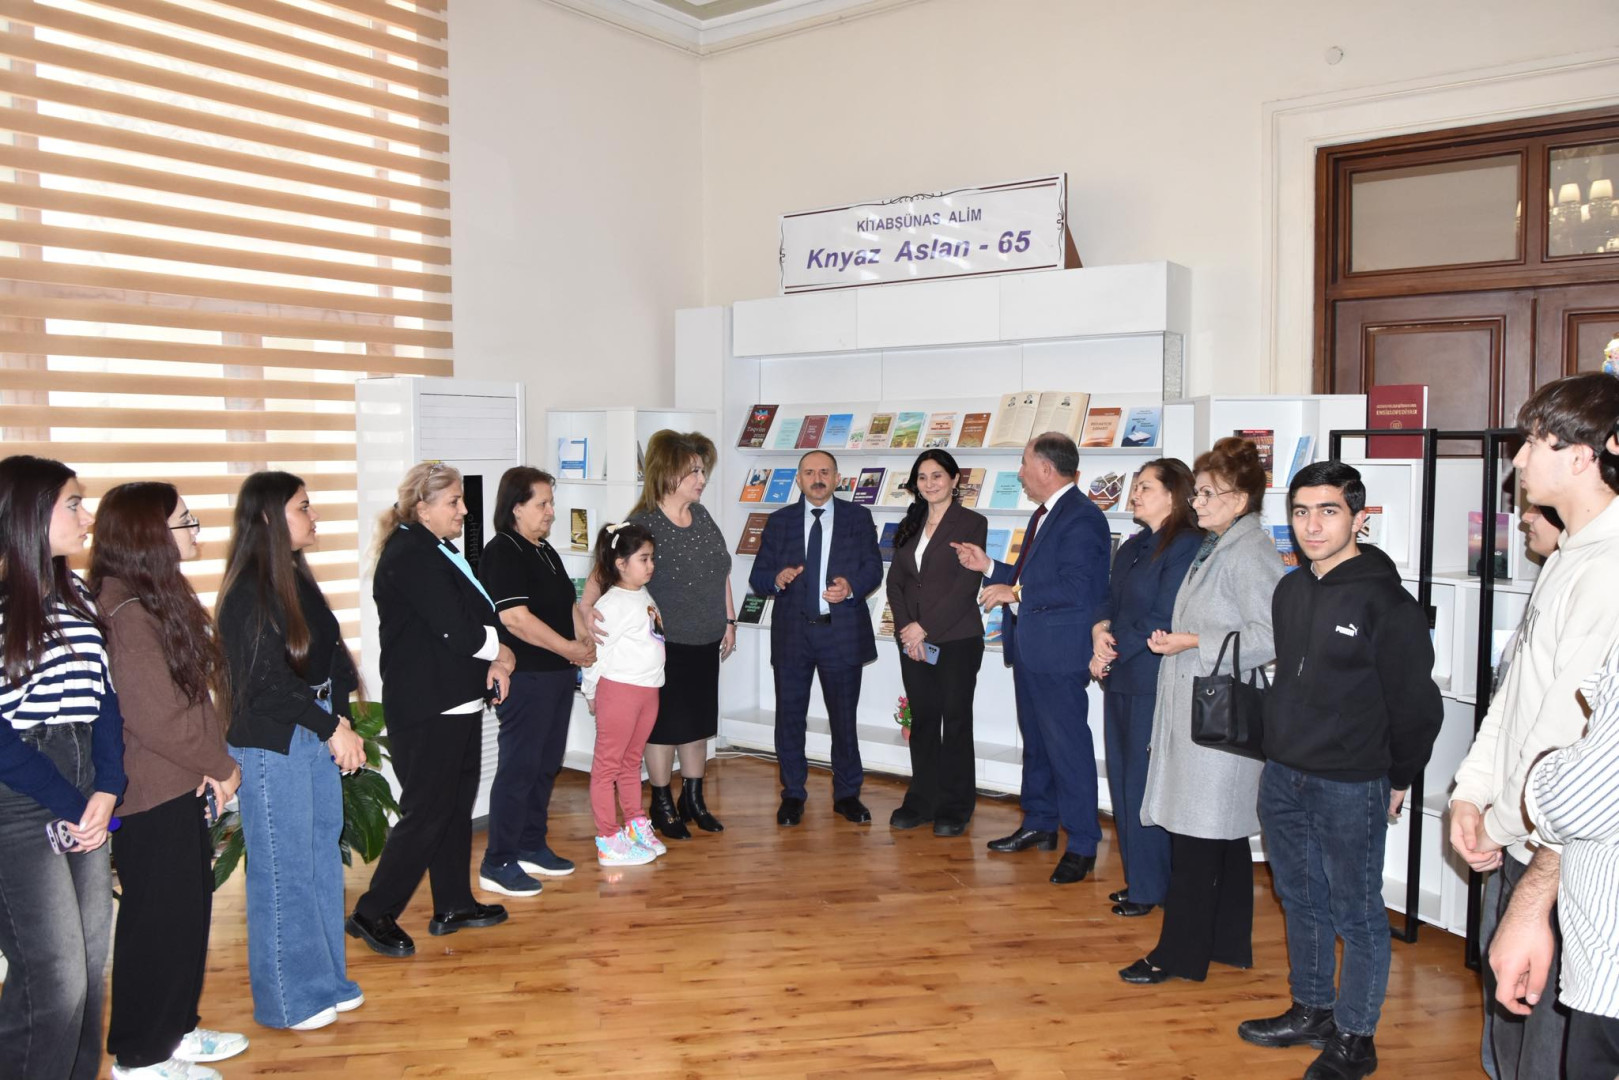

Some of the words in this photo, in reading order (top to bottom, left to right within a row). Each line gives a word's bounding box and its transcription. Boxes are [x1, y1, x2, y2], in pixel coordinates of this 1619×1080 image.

[856, 211, 941, 233] KİTABŞÜNAS
[948, 206, 982, 224] ALİM
[806, 247, 881, 272] Knyaz
[894, 238, 970, 263] Aslan
[997, 229, 1031, 254] 65
